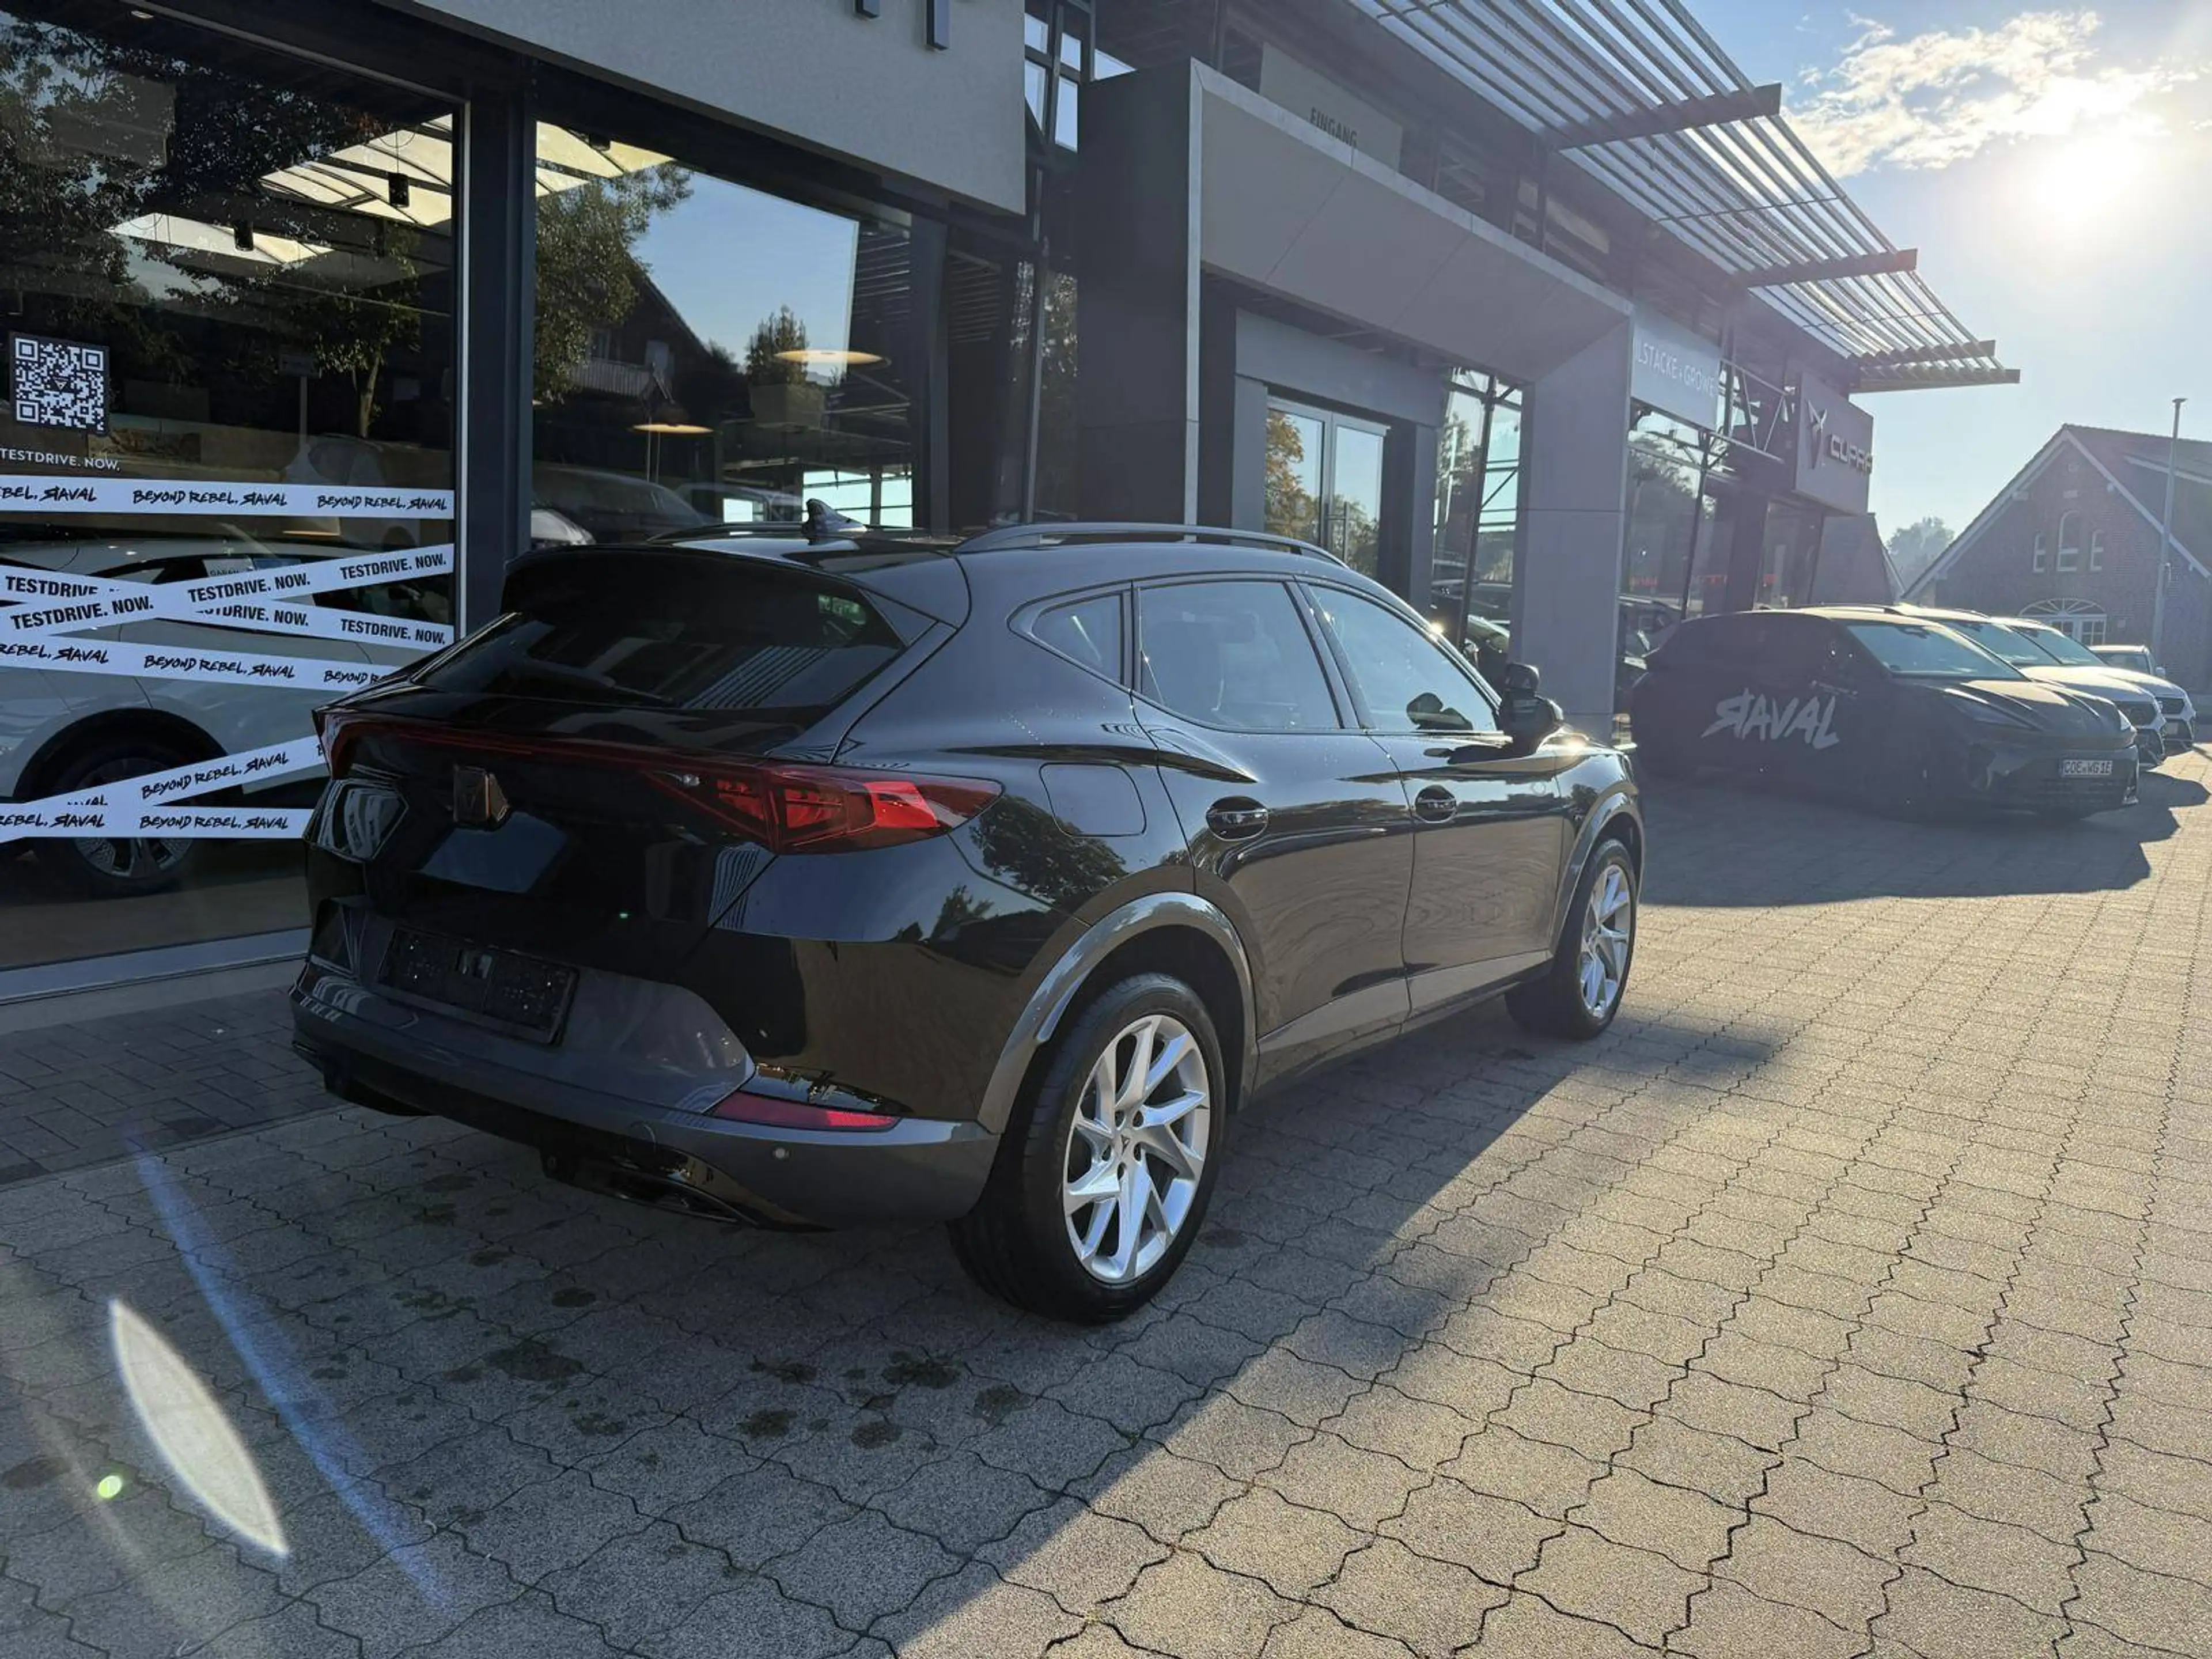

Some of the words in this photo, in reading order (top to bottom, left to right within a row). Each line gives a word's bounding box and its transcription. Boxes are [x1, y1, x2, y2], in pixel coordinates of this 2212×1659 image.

[1310, 106, 1358, 149] EINGANG
[0, 447, 81, 467] TESTDRIVE.
[84, 457, 121, 472] NOW.
[132, 490, 186, 505] BEYOND
[189, 490, 238, 505] REBEL.
[317, 495, 362, 509] BEYOND
[364, 497, 406, 510] REBEL.
[340, 558, 412, 581] TESTDRIVE.
[415, 552, 447, 568] NOW.
[188, 578, 271, 603] TESTDRIVE.
[275, 573, 310, 590] NOW.
[10, 603, 108, 630] TESTDRIVE.
[112, 596, 154, 615] NOW.
[274, 611, 309, 627] NOW.
[340, 619, 411, 640] TESTDRIVE.
[415, 628, 446, 645] NOW.
[143, 654, 196, 671] BEYOND
[199, 659, 247, 673] REBEL.
[323, 669, 368, 684] BEYOND
[142, 772, 192, 800] BEYOND
[194, 763, 242, 785] REBEL.
[139, 815, 192, 830] BEYOND
[194, 815, 241, 830] REBEL.
